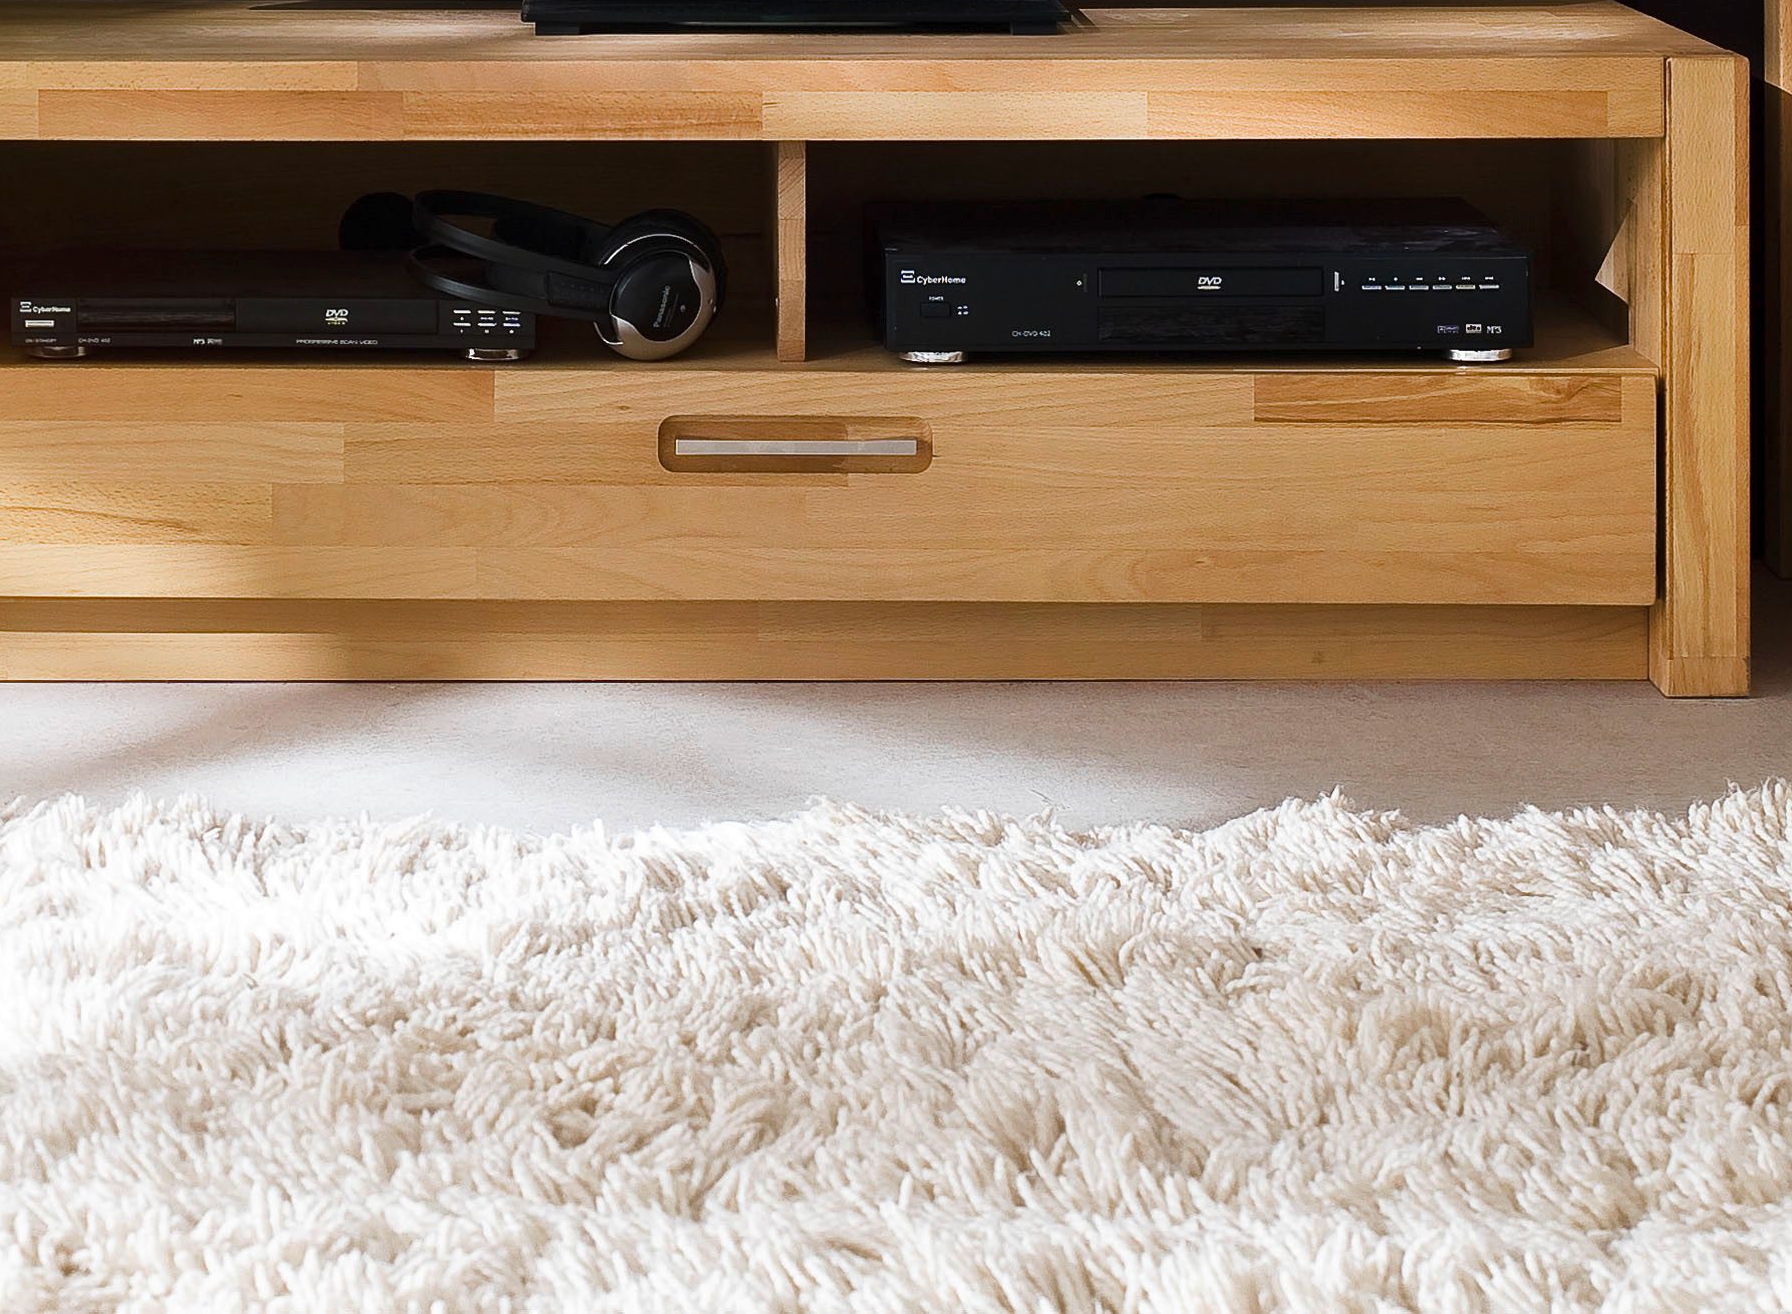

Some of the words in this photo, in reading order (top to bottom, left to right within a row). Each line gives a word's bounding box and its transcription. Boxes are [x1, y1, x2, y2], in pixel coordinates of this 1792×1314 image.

[916, 275, 967, 285] CyberHome
[1198, 276, 1223, 285] DVD
[32, 306, 72, 314] CyberHome
[653, 285, 671, 328] Panasonic
[325, 309, 349, 319] DVD
